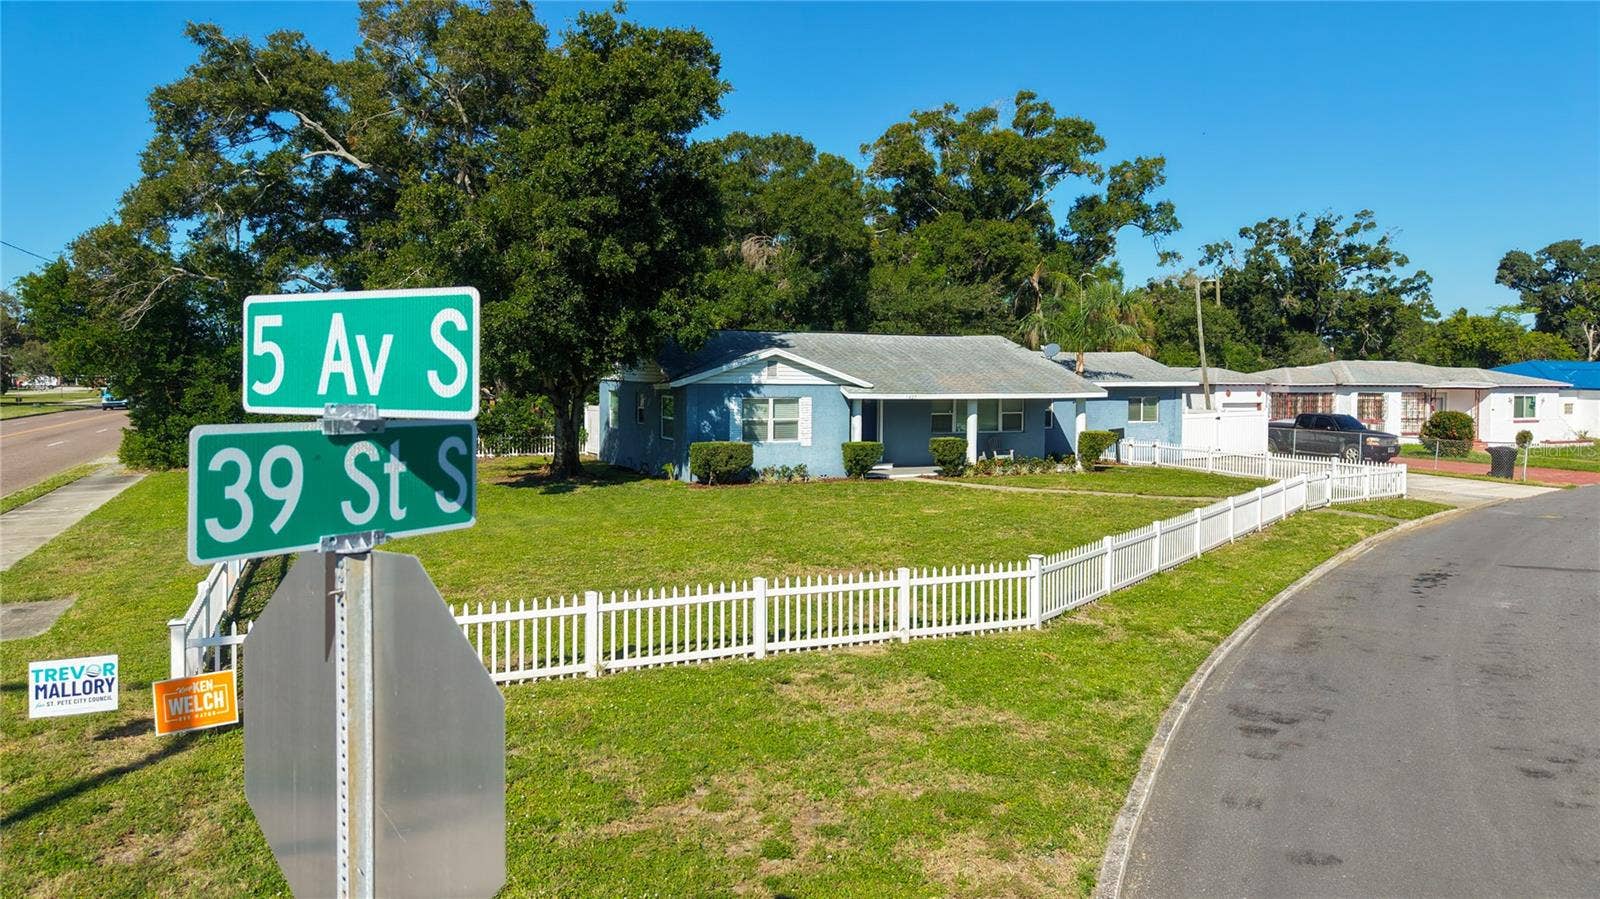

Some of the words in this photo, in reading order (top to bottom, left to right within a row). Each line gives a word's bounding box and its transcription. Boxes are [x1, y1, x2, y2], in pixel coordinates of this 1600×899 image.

[251, 314, 285, 396] 5
[317, 312, 394, 396] Av
[427, 307, 468, 398] S
[204, 444, 304, 543] 39
[340, 438, 407, 526] St
[435, 436, 468, 514] S
[31, 662, 116, 683] TREVOR
[34, 677, 115, 700] MALLORY
[192, 679, 214, 693] KEN
[88, 695, 113, 703] COUNCIL
[168, 690, 225, 716] WELCH
